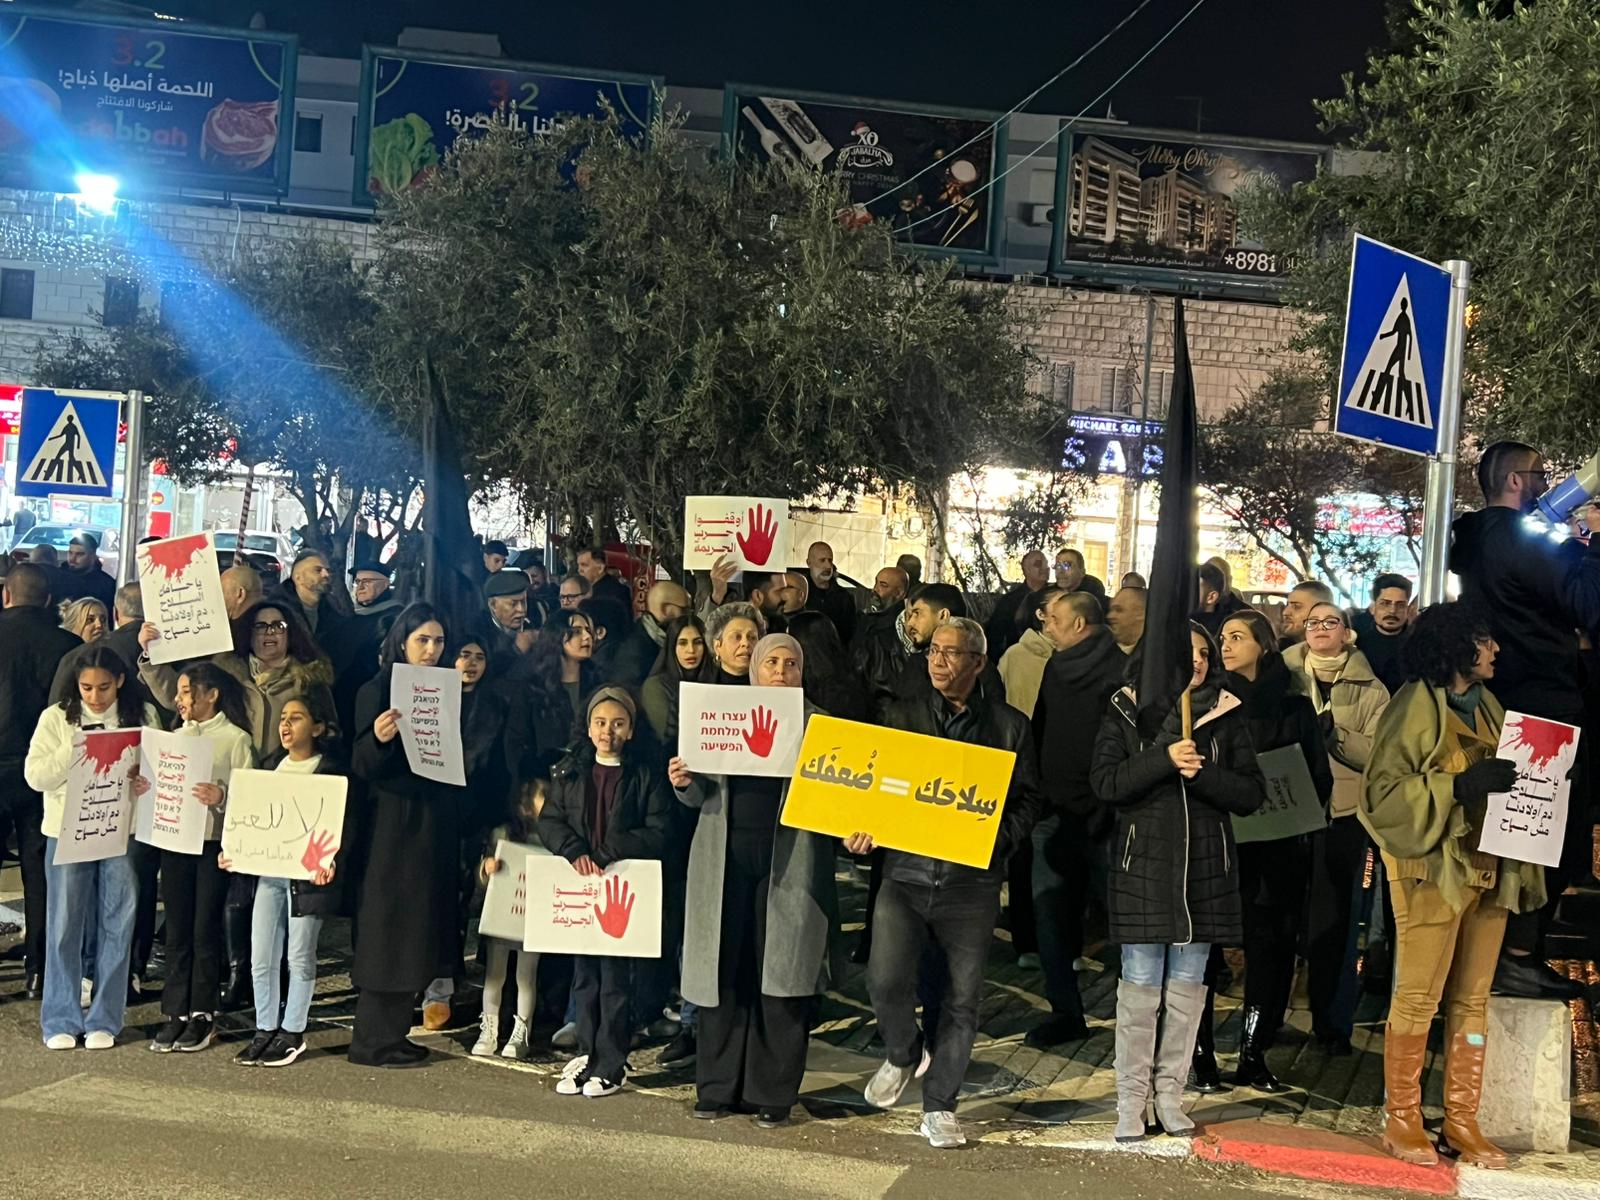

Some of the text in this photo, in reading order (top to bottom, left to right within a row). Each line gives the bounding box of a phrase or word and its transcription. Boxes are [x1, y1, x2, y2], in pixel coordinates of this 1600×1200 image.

[58, 68, 214, 99] اللحمة أصلها ذباح!
[96, 95, 174, 113] شاركونا الافتتاح
[858, 131, 879, 146] XO
[1068, 418, 1120, 433] MICHAEL
[694, 530, 734, 543] حرب
[694, 542, 736, 556] الجريمة
[159, 578, 204, 597] يا حامل
[160, 591, 204, 613] السلاح
[196, 606, 208, 620] دم
[163, 619, 211, 641] مش مباح
[700, 711, 748, 722] עצרו את
[700, 726, 741, 737] מלחמת
[700, 741, 744, 752] הפשיעה
[83, 777, 124, 794] يا حامل
[1552, 775, 1560, 791] يا
[81, 792, 122, 811] السلاح
[1510, 786, 1557, 802] السلاح
[109, 808, 120, 822] دم
[282, 796, 325, 845] لا
[1541, 809, 1553, 824] دم
[75, 822, 118, 842] مش مباح
[1500, 818, 1551, 837] مش مباح
[553, 882, 603, 899] أوقفوا
[552, 901, 592, 914] حرب
[552, 914, 595, 929] الجريمة
